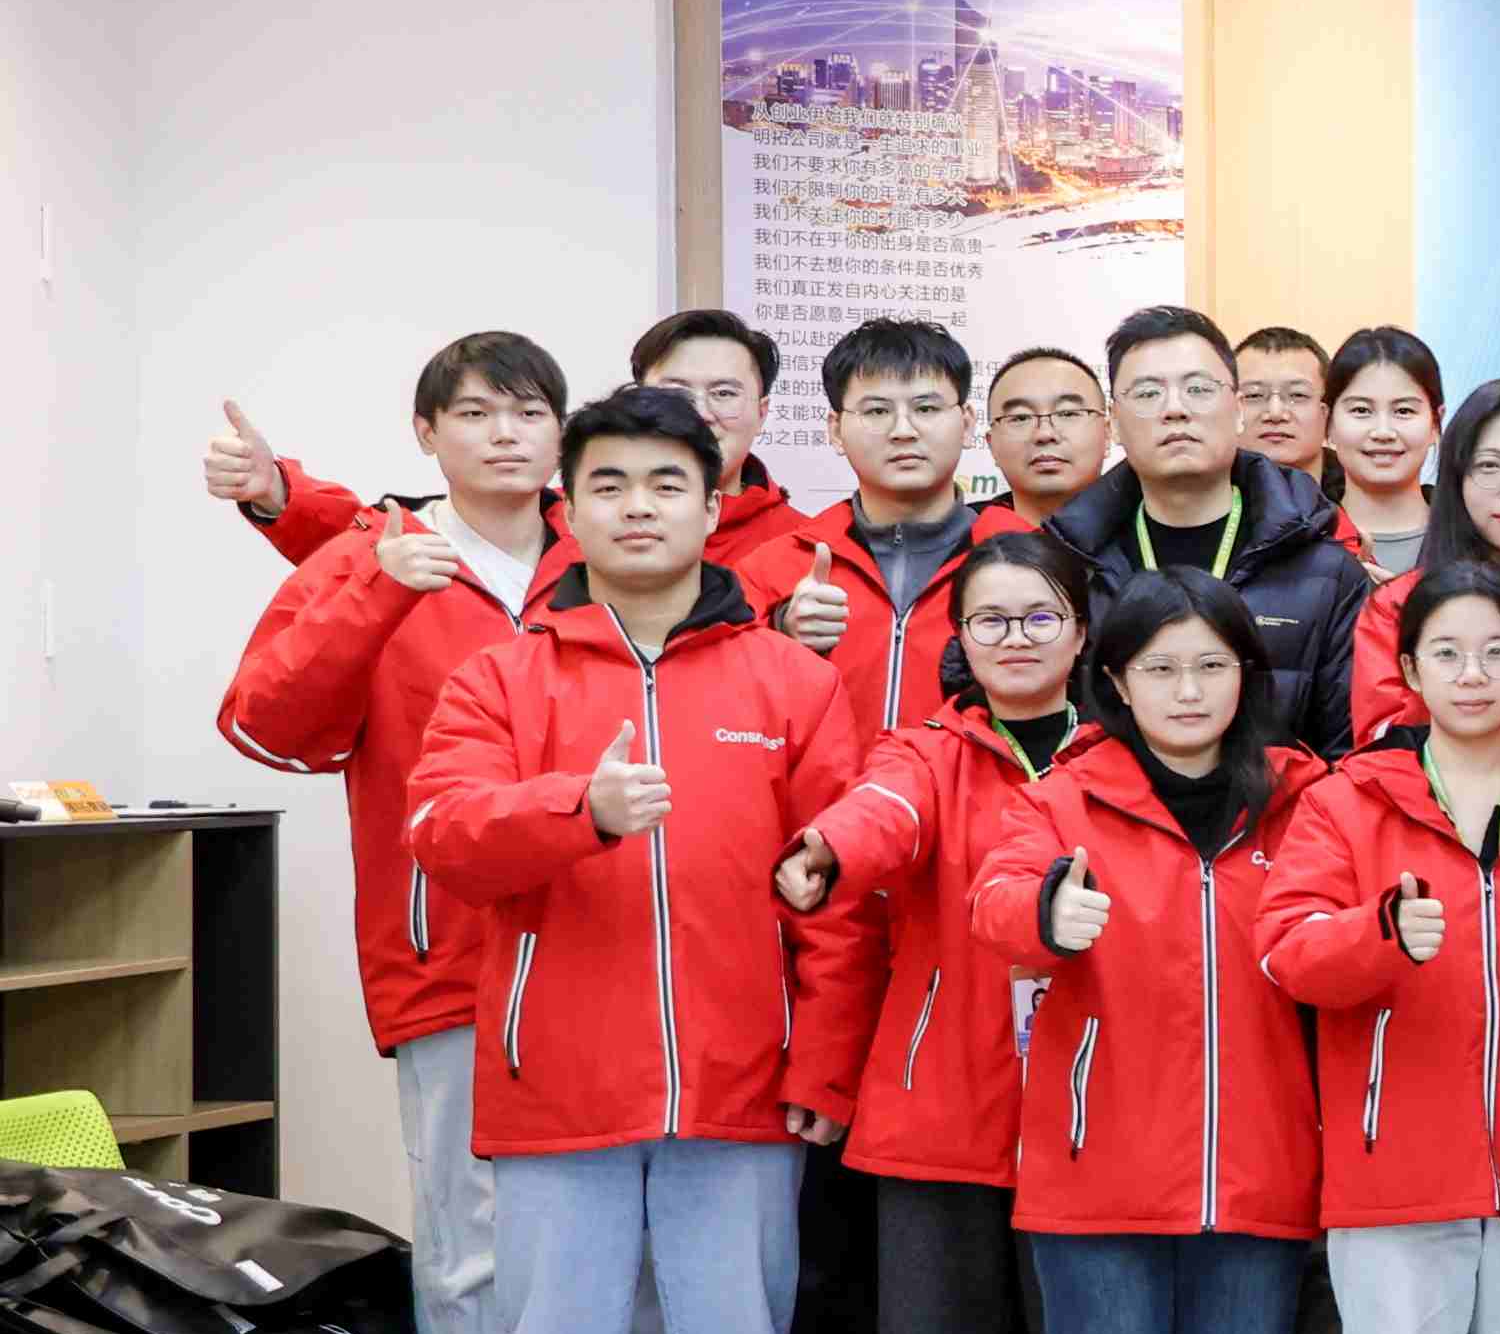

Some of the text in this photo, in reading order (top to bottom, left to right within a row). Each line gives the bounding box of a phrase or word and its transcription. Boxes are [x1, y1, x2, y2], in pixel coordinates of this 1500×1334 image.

[752, 102, 963, 133] 从创业伊始我们就特别确认
[752, 129, 983, 157] 明拓公司就是一生追求的事业
[752, 153, 967, 180] 我们不要求你有多高的学历
[752, 178, 969, 207] 我们不限制你的年龄有多大
[753, 203, 965, 230] 我们不关注你的才能有多少
[754, 228, 984, 256] 我们不在乎你的出身是否高贵
[754, 253, 985, 280] 我们不去想你的条件是否优秀
[754, 278, 968, 303] 我们真正发自内心关注的是
[755, 303, 969, 328] 你是否愿意与明拓公司一起
